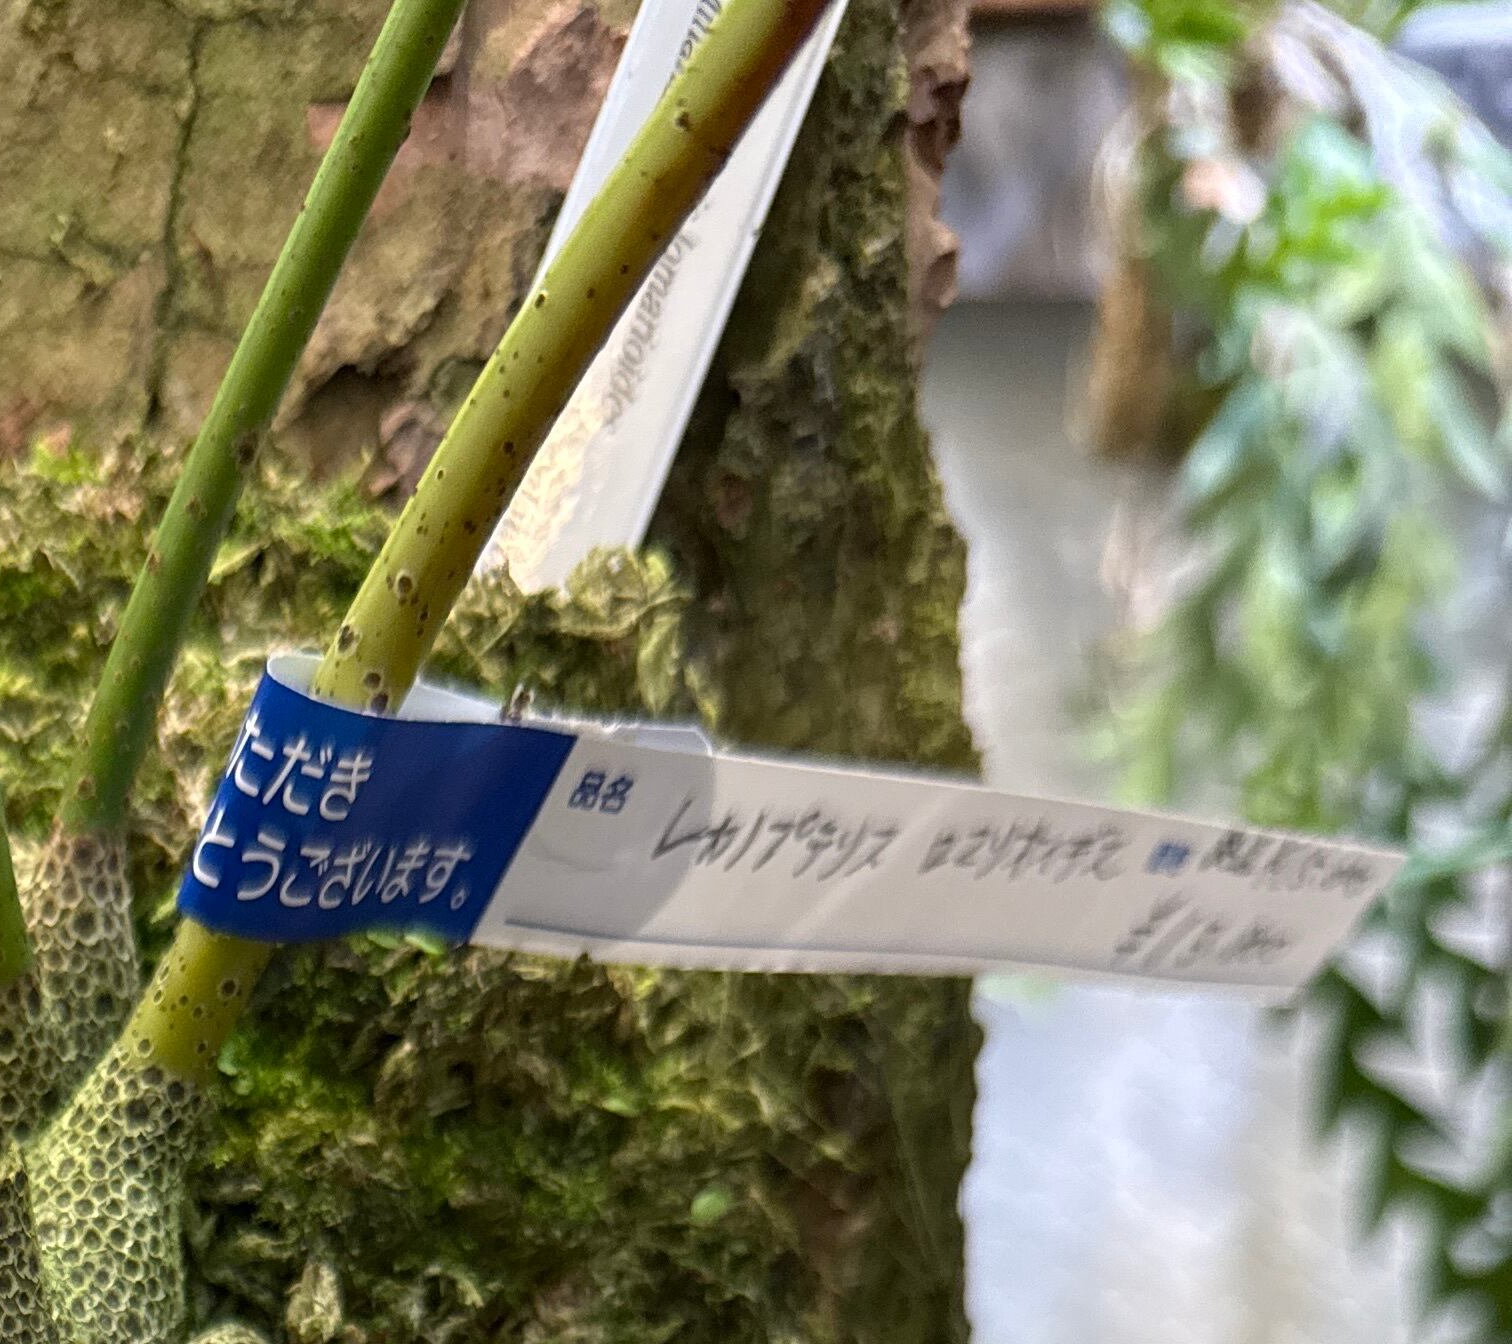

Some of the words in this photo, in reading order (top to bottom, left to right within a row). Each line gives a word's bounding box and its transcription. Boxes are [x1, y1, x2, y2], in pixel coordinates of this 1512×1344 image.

[226, 715, 372, 822] ただき
[568, 770, 635, 814] 品名
[192, 812, 471, 911] とうございます。
